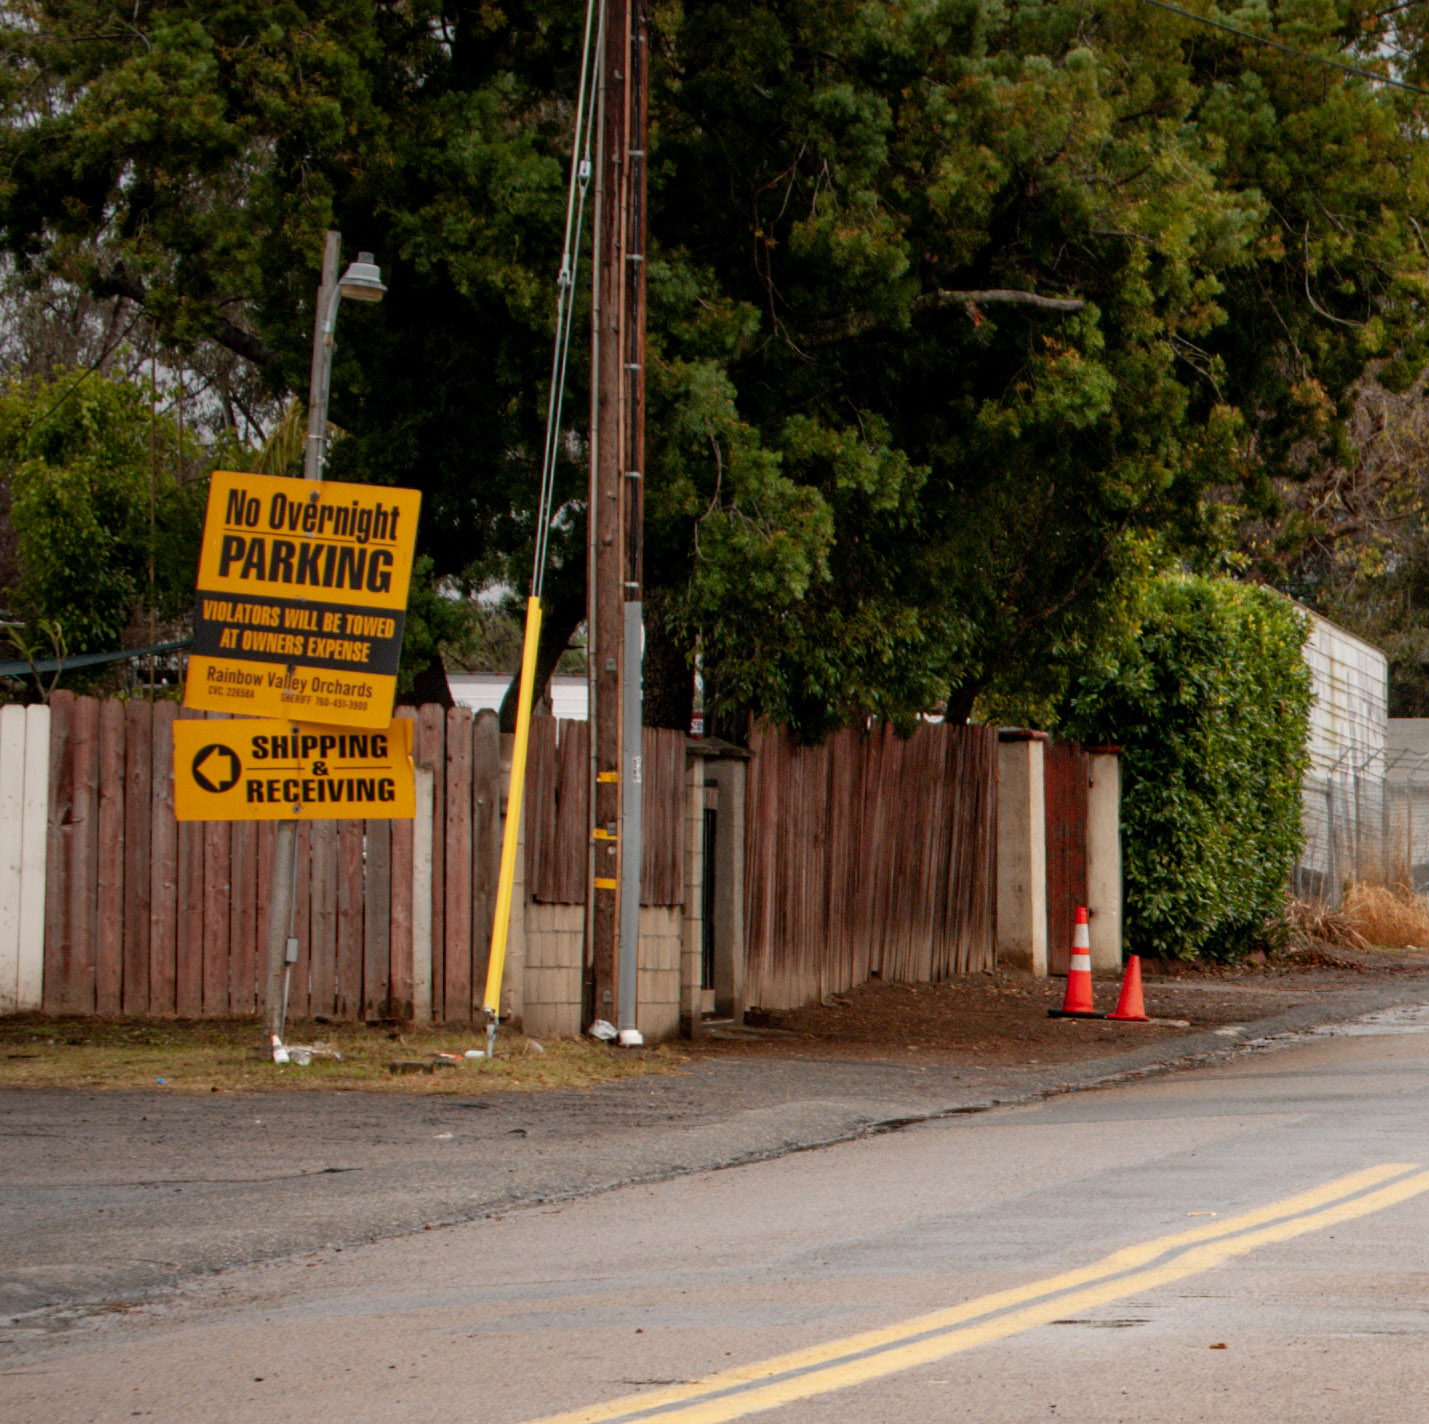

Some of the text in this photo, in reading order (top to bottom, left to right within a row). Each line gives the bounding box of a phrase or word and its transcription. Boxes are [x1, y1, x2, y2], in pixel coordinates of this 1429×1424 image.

[225, 488, 400, 544] No Overnight
[218, 534, 394, 593] PARKING
[202, 599, 396, 639] VIOLATORS WILL BE TOWED
[219, 627, 372, 663] AT OWNERS EXPENSE
[207, 666, 373, 698] Rainbow Valley Orchards
[280, 693, 312, 704] SHERIFF
[251, 734, 388, 759] SHIPPING
[312, 761, 328, 776] &
[246, 778, 396, 803] RECEIVING
